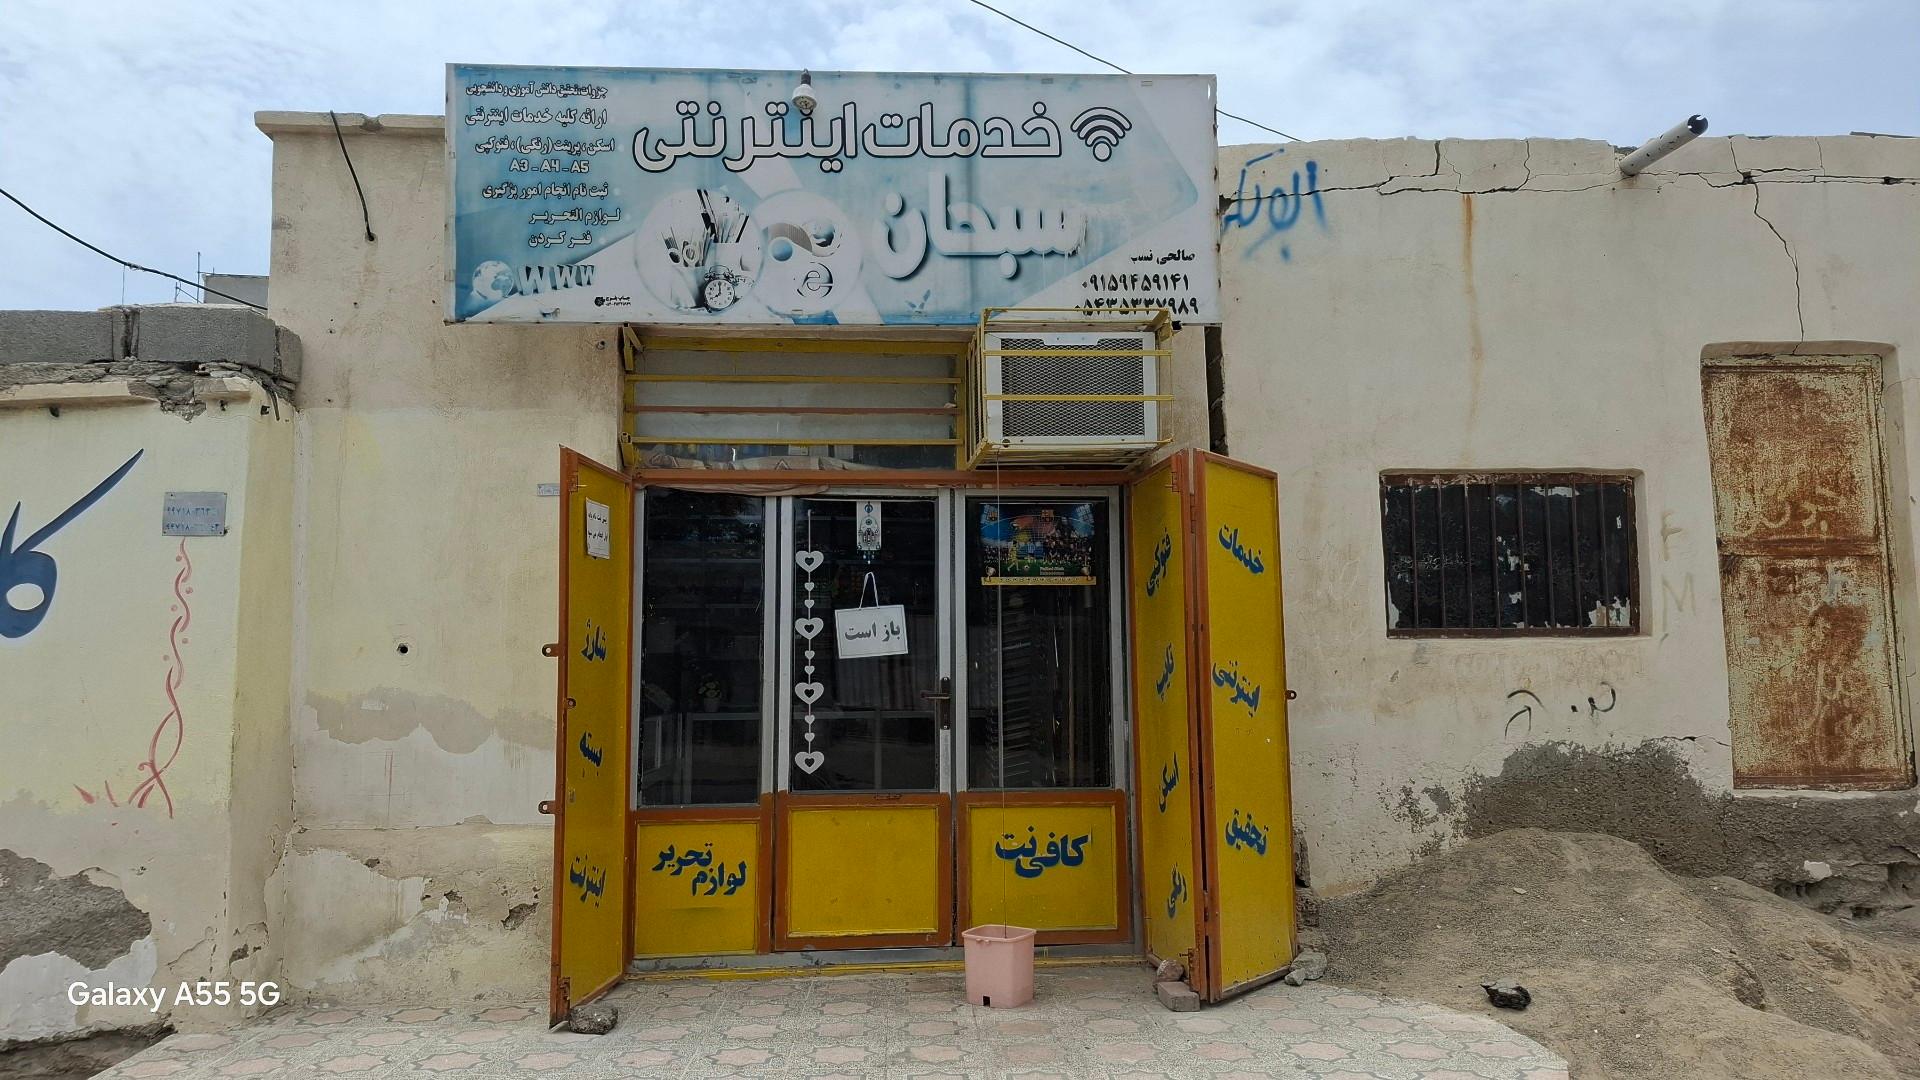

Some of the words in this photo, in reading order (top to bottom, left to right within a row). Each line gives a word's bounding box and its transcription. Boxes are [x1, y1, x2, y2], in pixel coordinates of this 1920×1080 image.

[465, 106, 509, 126] اینترنتی
[510, 107, 553, 125] خدمات
[555, 108, 577, 127] کلیه
[579, 108, 607, 129] ارائه
[632, 100, 858, 173] اینترنتی
[862, 101, 1063, 159] خدمات
[475, 135, 509, 154] فتوکپی
[509, 158, 529, 172] A3
[540, 159, 560, 172] A4
[570, 160, 590, 173] A5
[519, 182, 542, 199] امور
[544, 184, 572, 199] انجام
[572, 185, 587, 200] نام
[588, 183, 608, 198] ثبت
[529, 207, 583, 225] التحریر
[584, 208, 621, 225] لوازم
[872, 171, 1089, 280] سبحان
[528, 230, 567, 249] کردن
[568, 231, 593, 248] فنر
[1130, 249, 1154, 265] نسب
[1156, 249, 1196, 265] صالحی
[1218, 524, 1265, 575] خدمات
[844, 621, 877, 641] است
[882, 619, 901, 642] باز
[1225, 808, 1268, 856] تحقیق
[995, 825, 1038, 859] نت
[651, 842, 714, 876] تحریر
[1015, 832, 1090, 878] کافی
[691, 860, 747, 896] لوازم
